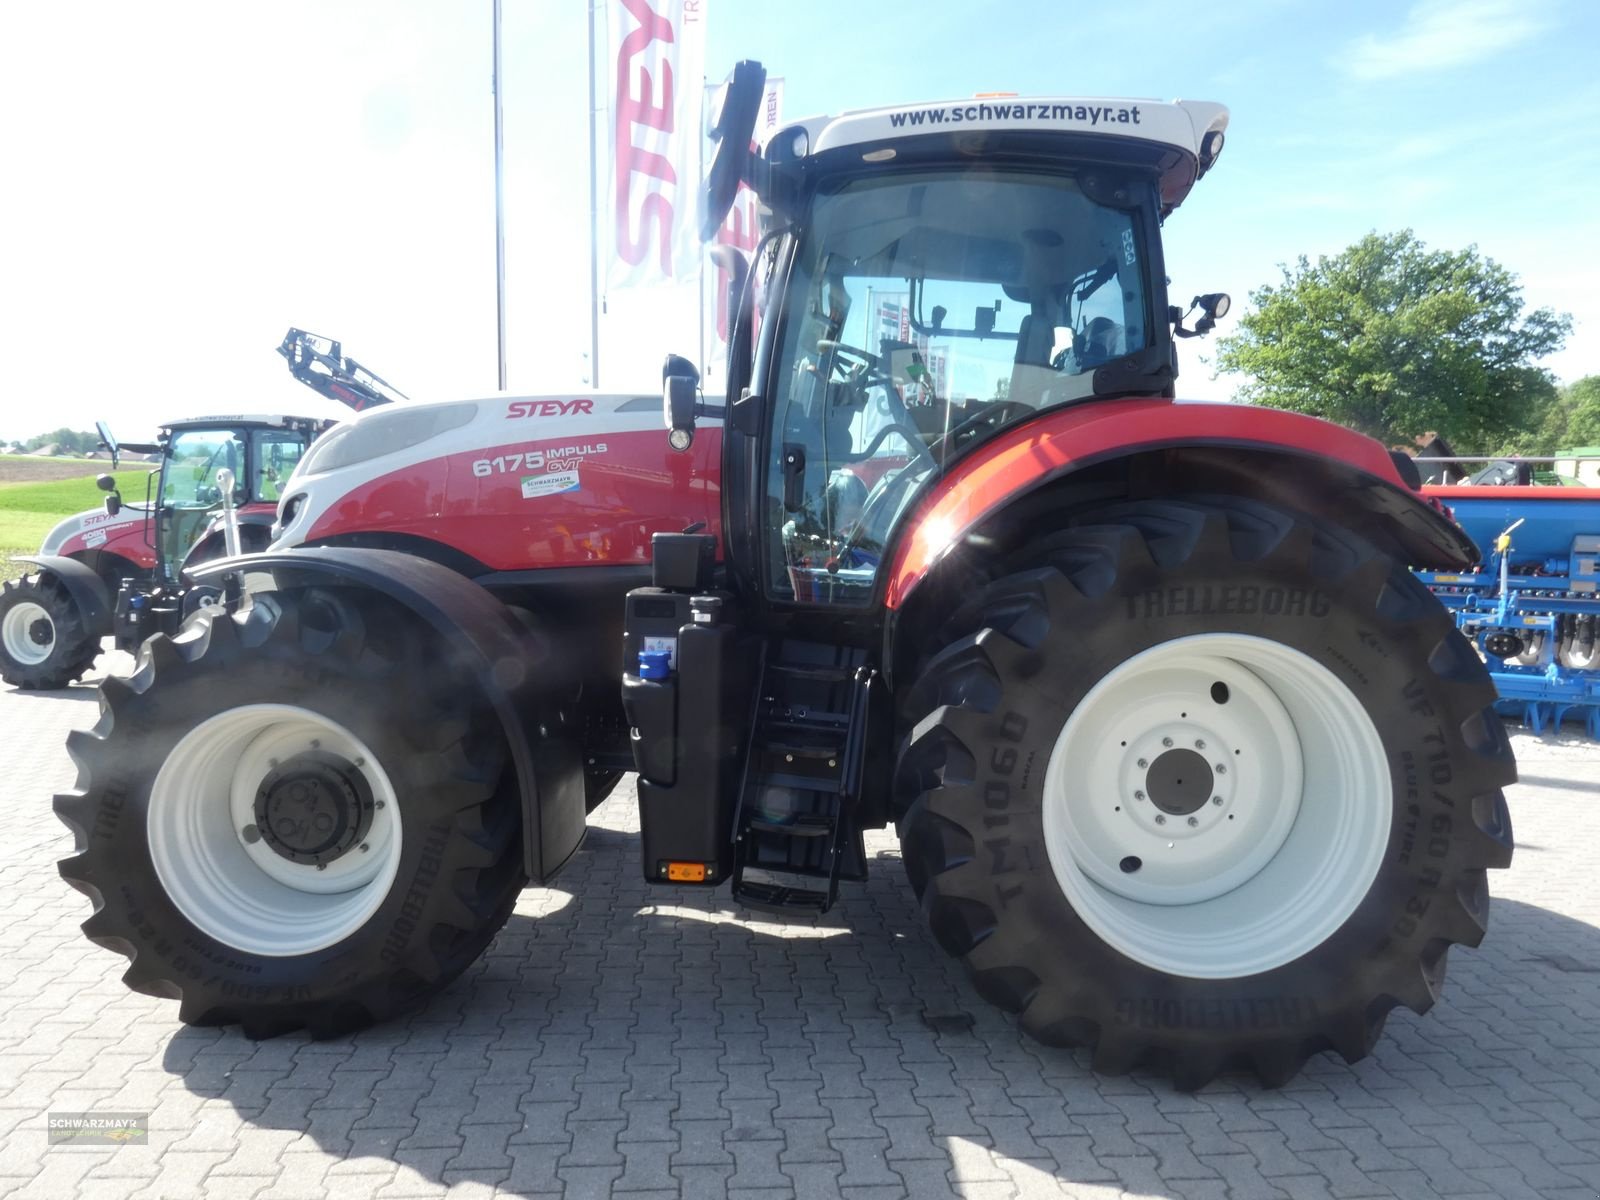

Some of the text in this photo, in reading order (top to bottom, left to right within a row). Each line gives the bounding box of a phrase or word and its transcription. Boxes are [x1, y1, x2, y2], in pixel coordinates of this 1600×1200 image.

[890, 103, 1141, 128] www.schwarzmayr.at
[505, 399, 594, 419] STEYR
[473, 443, 608, 477] 6175 IMPULS
[546, 456, 584, 473] CVT
[1121, 584, 1330, 620] TRELLEBORG
[983, 711, 1029, 911] TM1060
